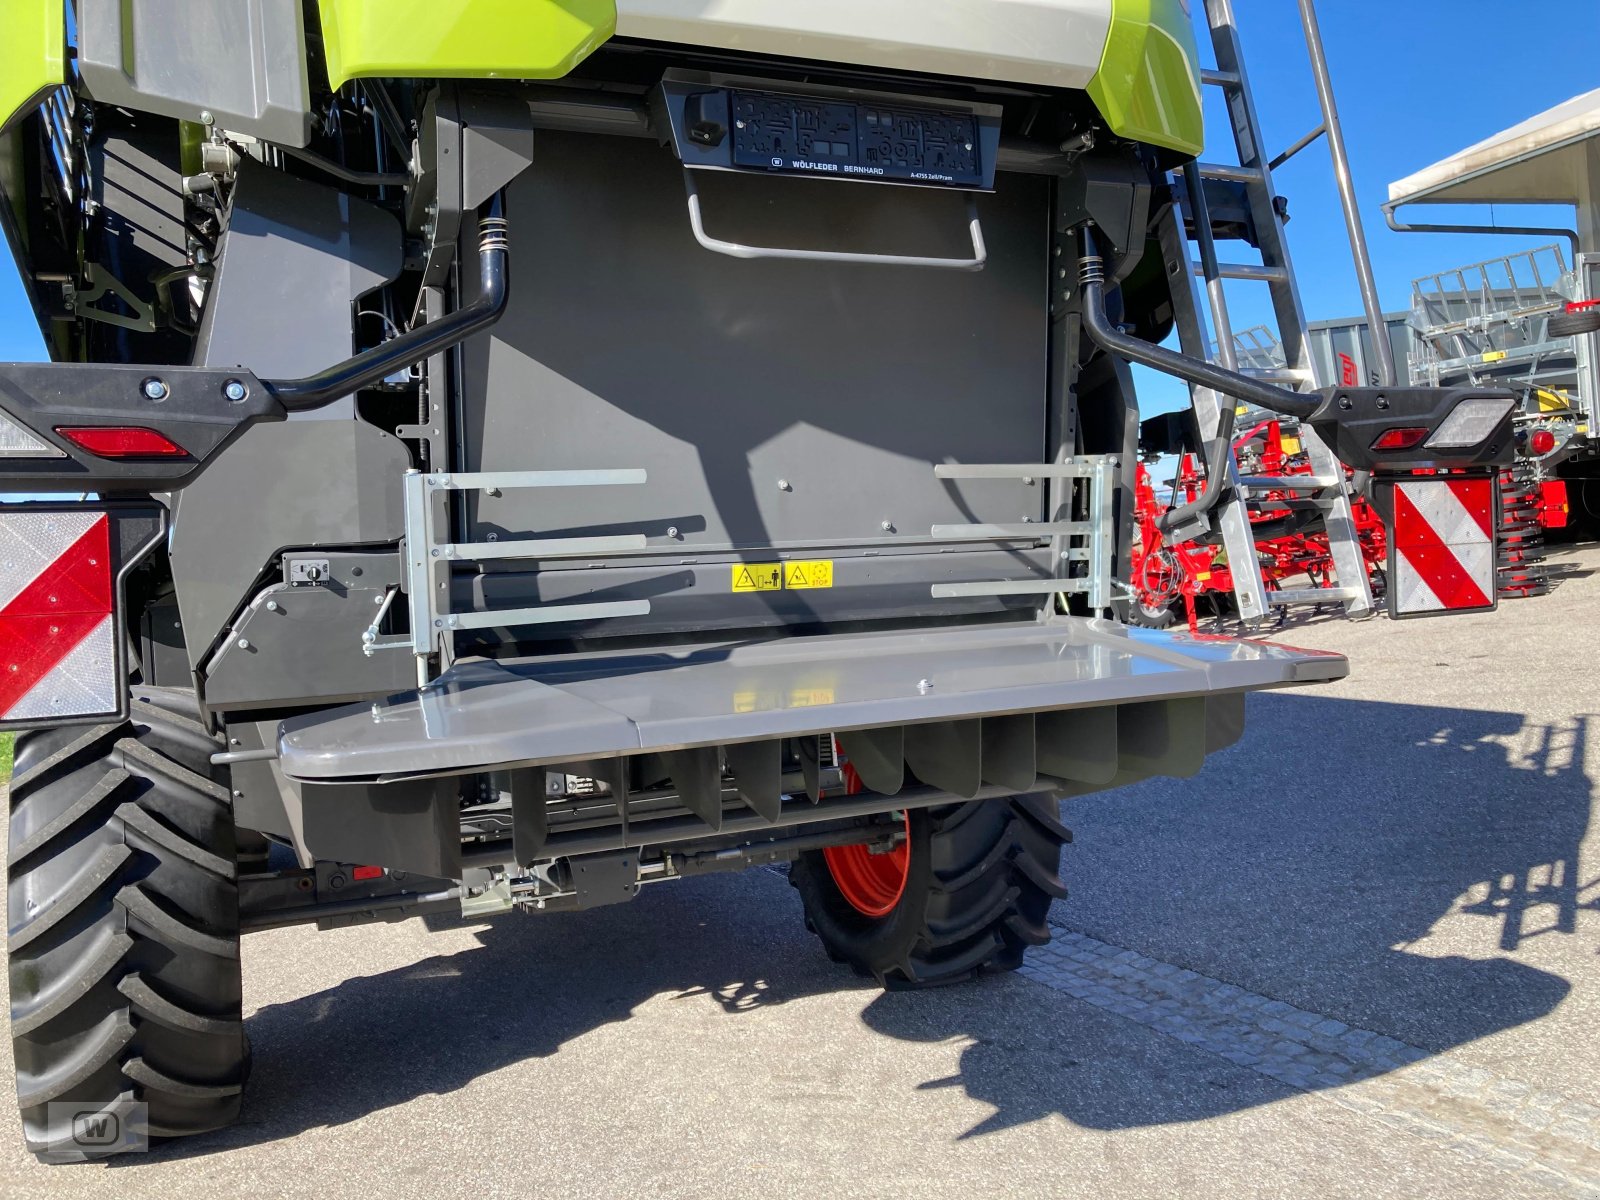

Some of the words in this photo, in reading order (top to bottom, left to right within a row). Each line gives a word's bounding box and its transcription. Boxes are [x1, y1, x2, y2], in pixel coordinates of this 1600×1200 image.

[792, 160, 838, 171] WÖLFLEDER
[844, 165, 884, 175] BERNHARD
[928, 173, 953, 181] Zell/Pram
[1338, 352, 1358, 387] egl
